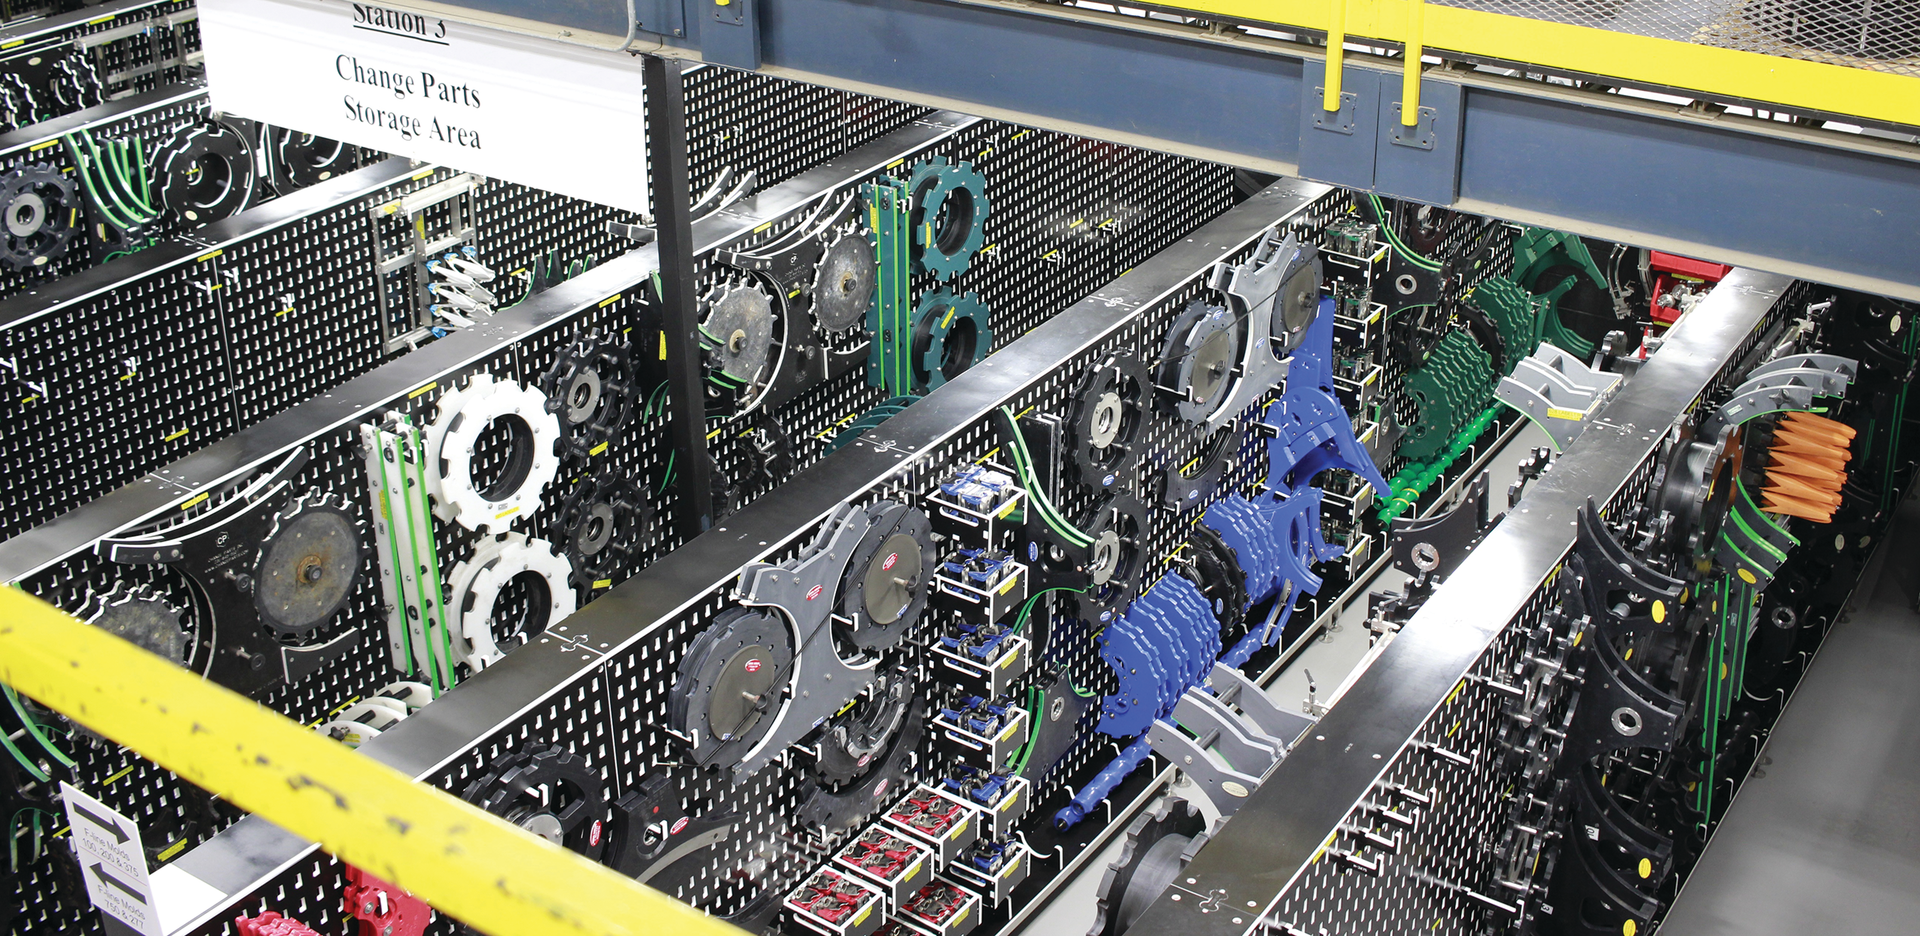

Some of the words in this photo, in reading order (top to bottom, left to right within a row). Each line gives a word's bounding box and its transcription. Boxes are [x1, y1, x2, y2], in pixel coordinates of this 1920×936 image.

[353, 3, 427, 35] Station
[336, 54, 415, 99] Change
[421, 71, 481, 108] Parts
[344, 95, 421, 141] Storage
[429, 116, 481, 149] Area
[217, 534, 228, 545] CP
[84, 827, 106, 847] F-line
[106, 841, 130, 861] Molds
[100, 847, 115, 863] 200
[116, 857, 123, 867] &
[124, 862, 139, 877] 375
[97, 884, 120, 904] F-line
[121, 898, 146, 920] Molds
[105, 899, 121, 915] 750
[122, 909, 128, 920] &
[129, 914, 144, 929] 277
